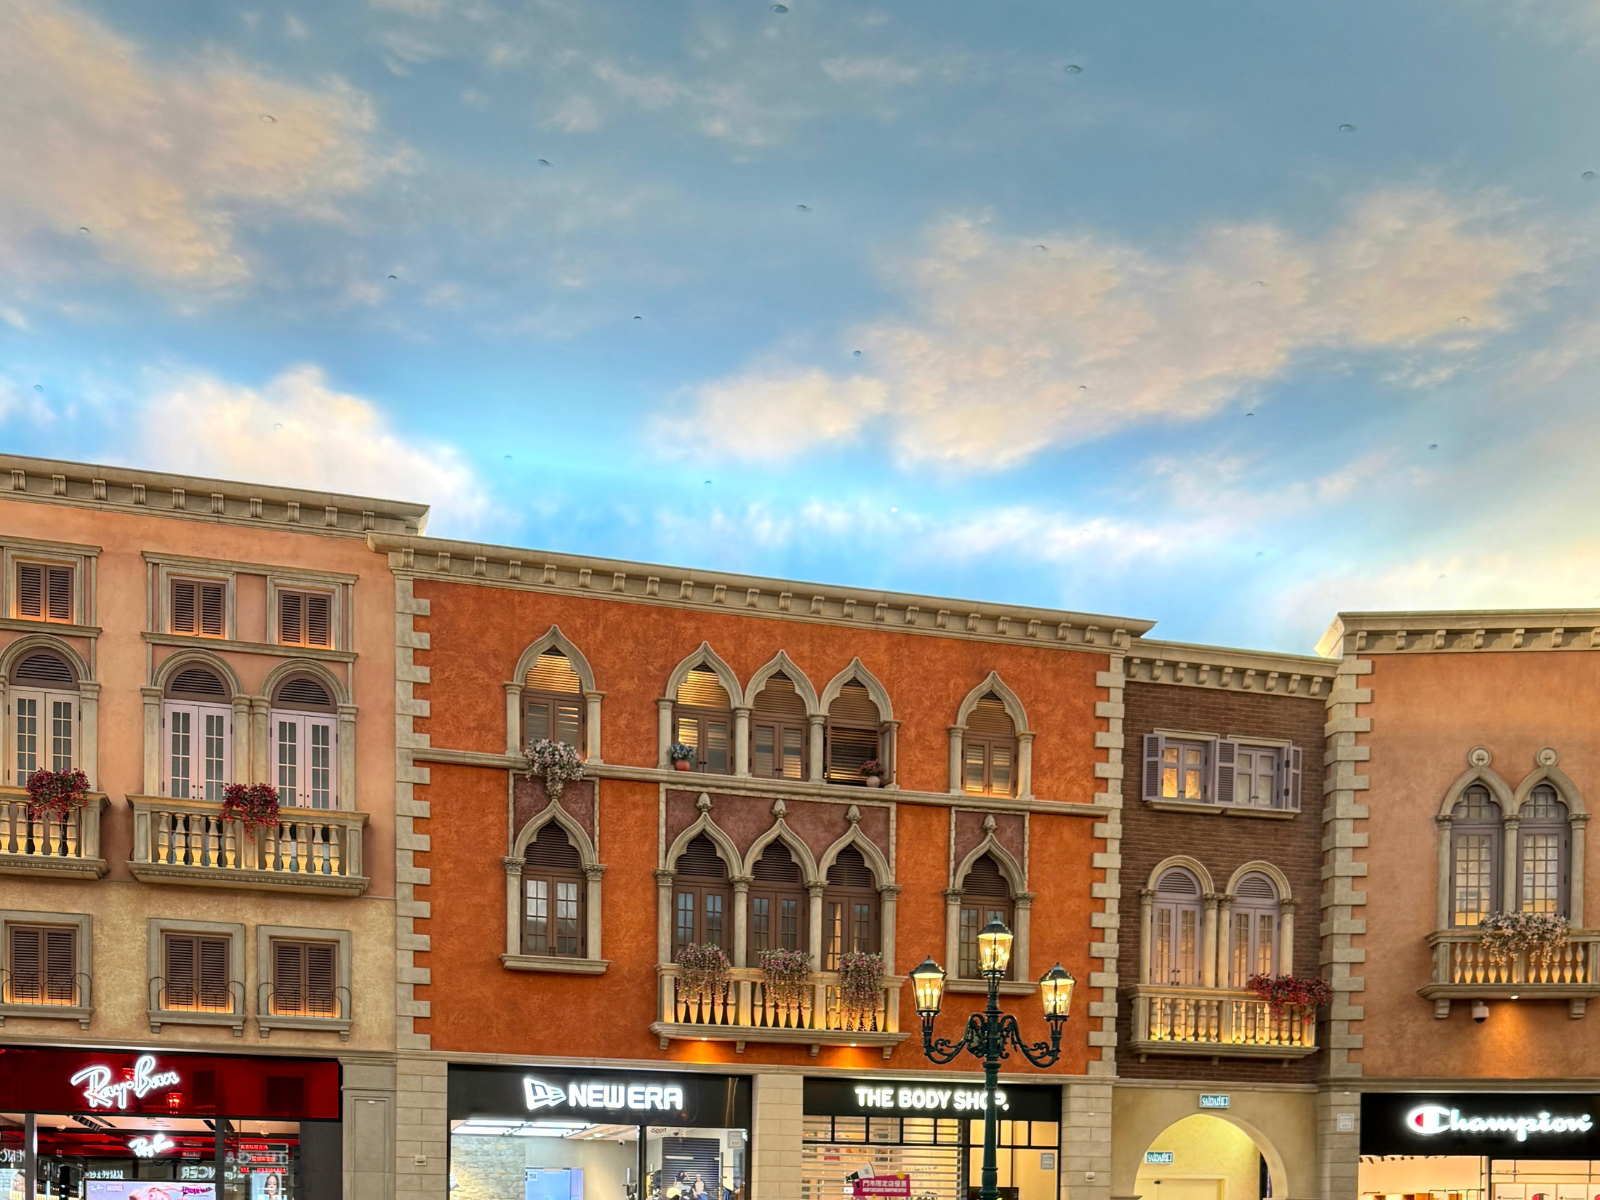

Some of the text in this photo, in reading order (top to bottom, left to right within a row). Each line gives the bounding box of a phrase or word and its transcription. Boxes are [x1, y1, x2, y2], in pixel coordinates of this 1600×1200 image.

[568, 1083, 684, 1110] NEW ERA
[854, 1088, 894, 1108] THE
[899, 1090, 952, 1110] BODY
[1407, 1105, 1593, 1142] Champion
